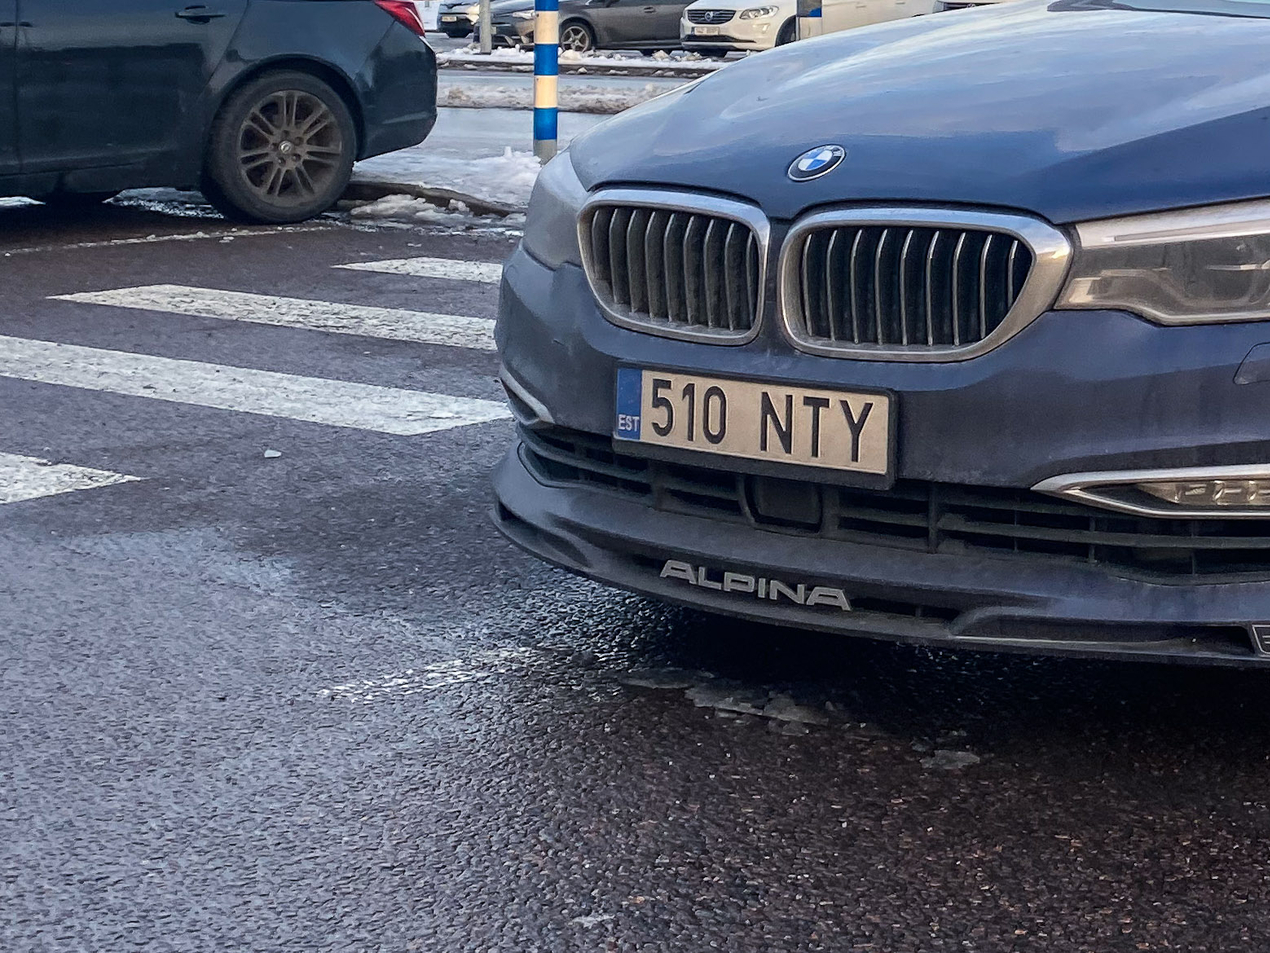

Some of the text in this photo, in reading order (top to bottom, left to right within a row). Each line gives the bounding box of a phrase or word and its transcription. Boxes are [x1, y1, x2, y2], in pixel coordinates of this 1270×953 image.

[618, 414, 640, 432] EST
[651, 378, 873, 462] 510 NTY
[659, 559, 850, 611] ALPINA
